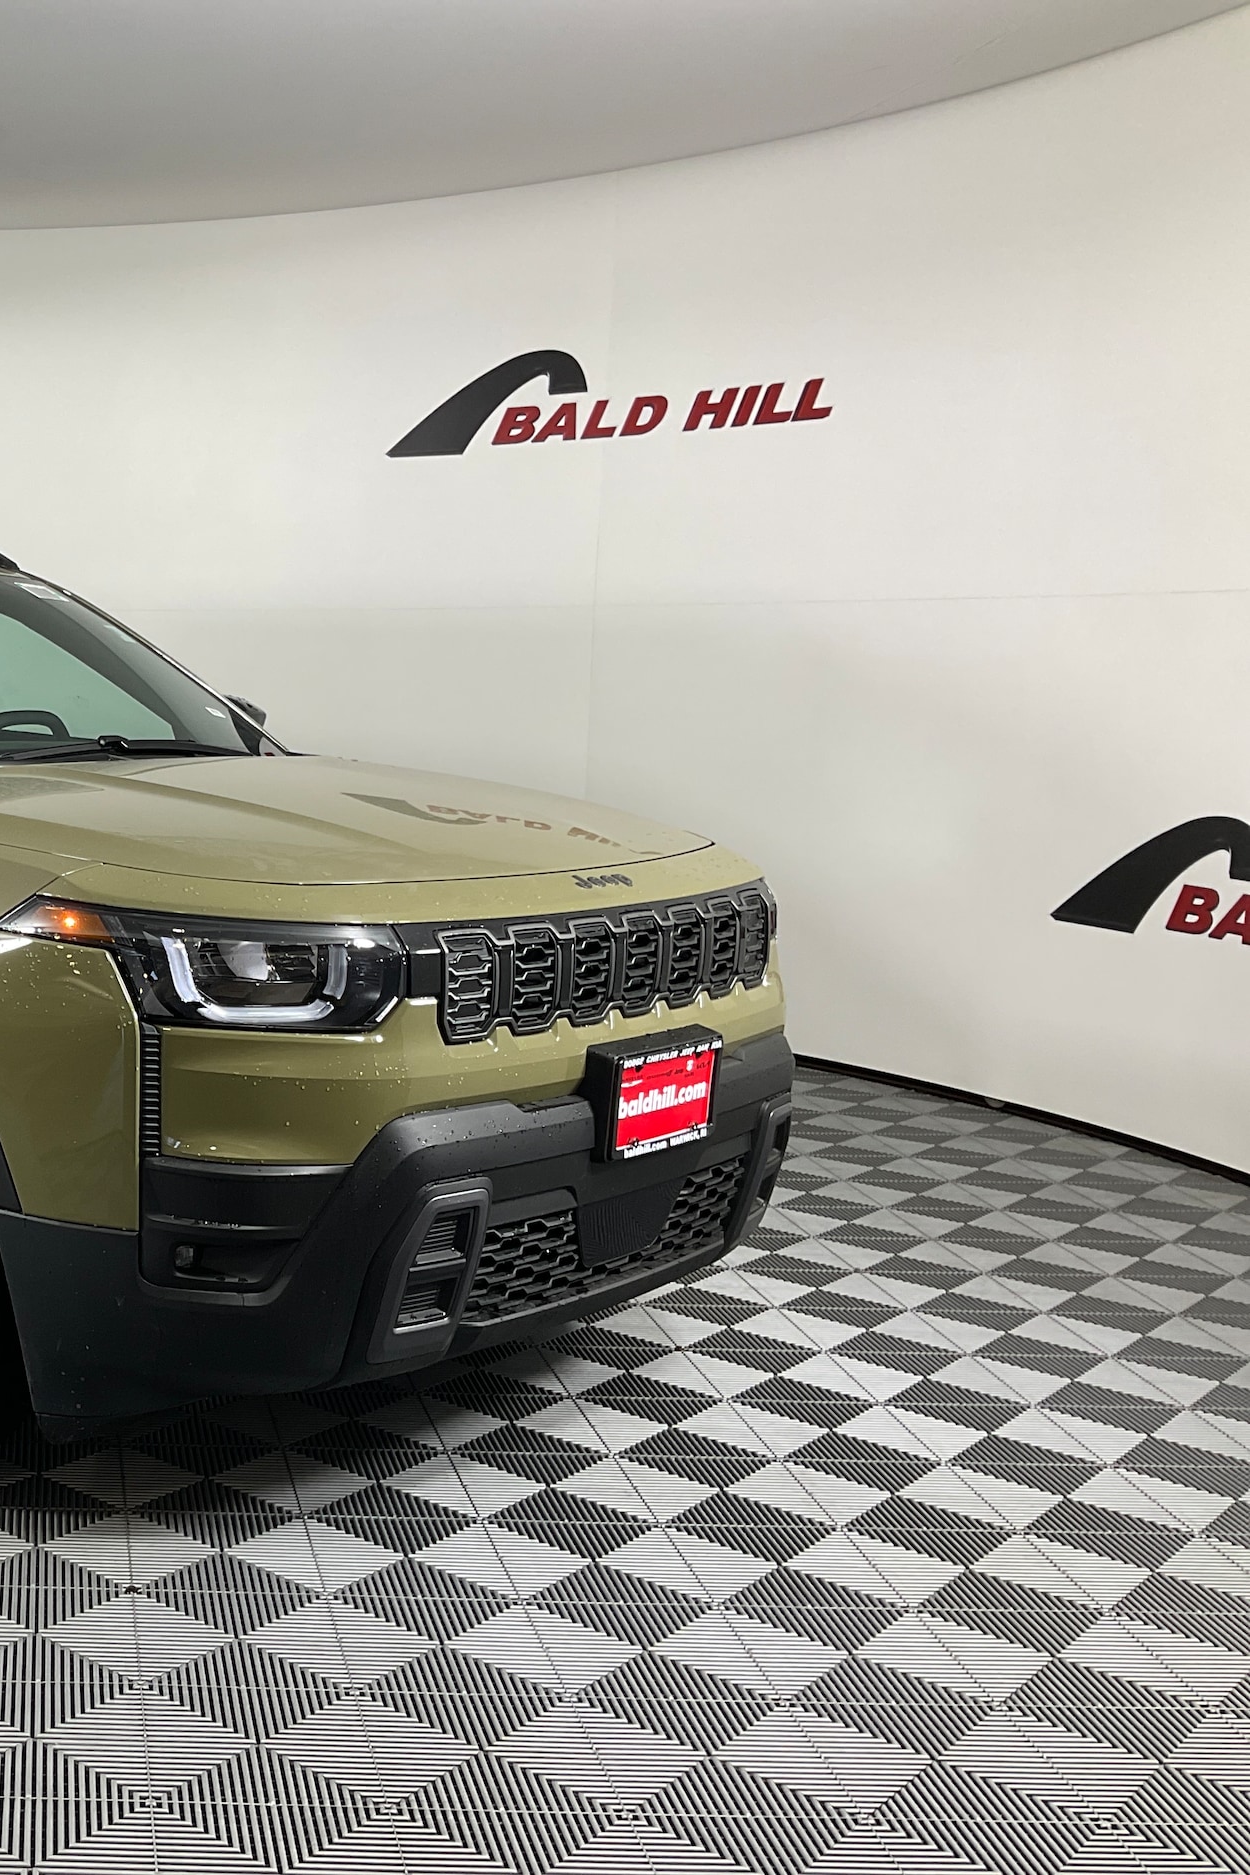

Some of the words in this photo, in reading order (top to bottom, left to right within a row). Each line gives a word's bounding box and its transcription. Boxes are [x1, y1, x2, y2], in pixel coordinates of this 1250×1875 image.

[491, 395, 669, 446] BALD
[682, 378, 833, 432] HILL
[571, 873, 634, 889] Jeep
[618, 1082, 707, 1119] baldhill.com
[623, 1140, 668, 1159] baldhill.com
